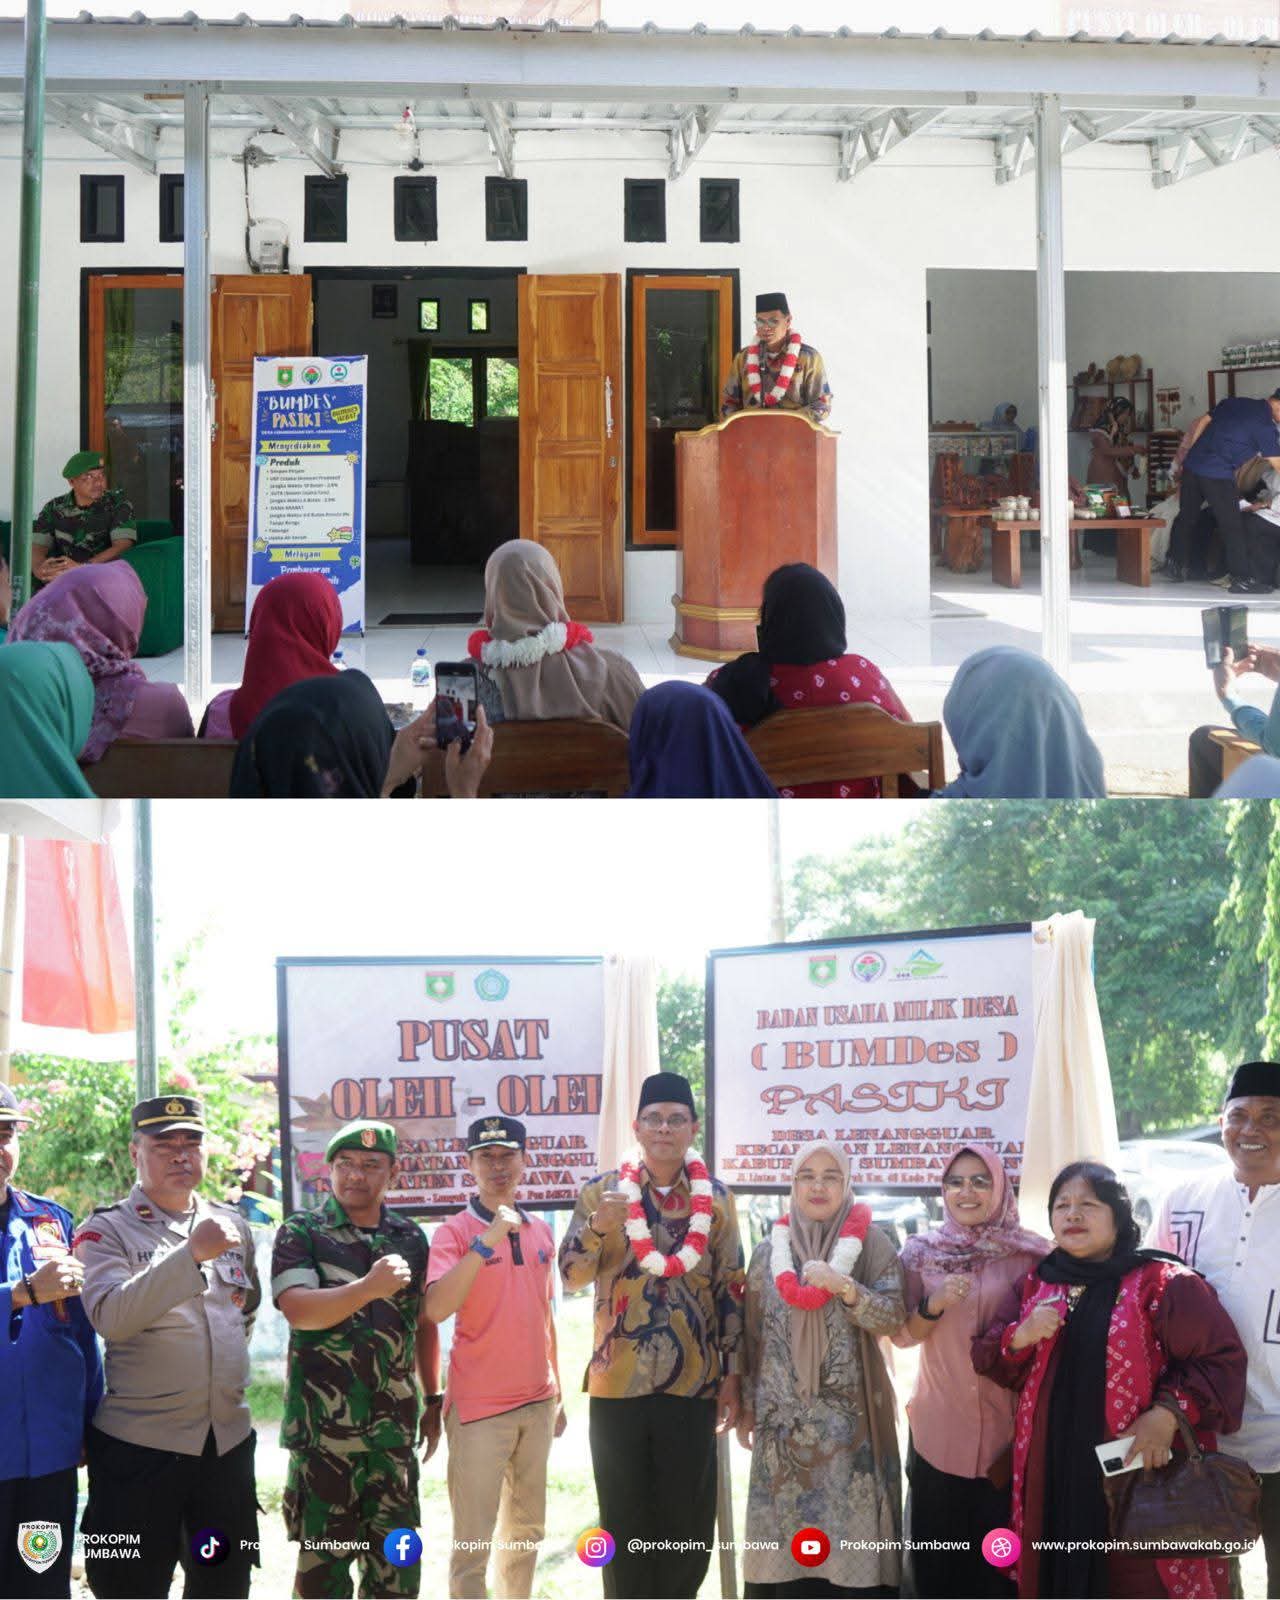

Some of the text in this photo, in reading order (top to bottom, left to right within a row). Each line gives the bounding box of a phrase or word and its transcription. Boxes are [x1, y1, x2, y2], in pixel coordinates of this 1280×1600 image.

[272, 412, 321, 428] PASIKI
[268, 442, 321, 452] Menyediakan
[270, 458, 301, 467] Produk
[757, 995, 1018, 1030] BADAN USAHA MILIK DESA
[396, 1019, 549, 1061] PUSAT
[782, 1036, 981, 1070] BUMDes
[331, 1076, 456, 1120] OLEH
[760, 1076, 1009, 1116] PASIKI
[772, 1127, 995, 1142] DESA LENANGGUAR
